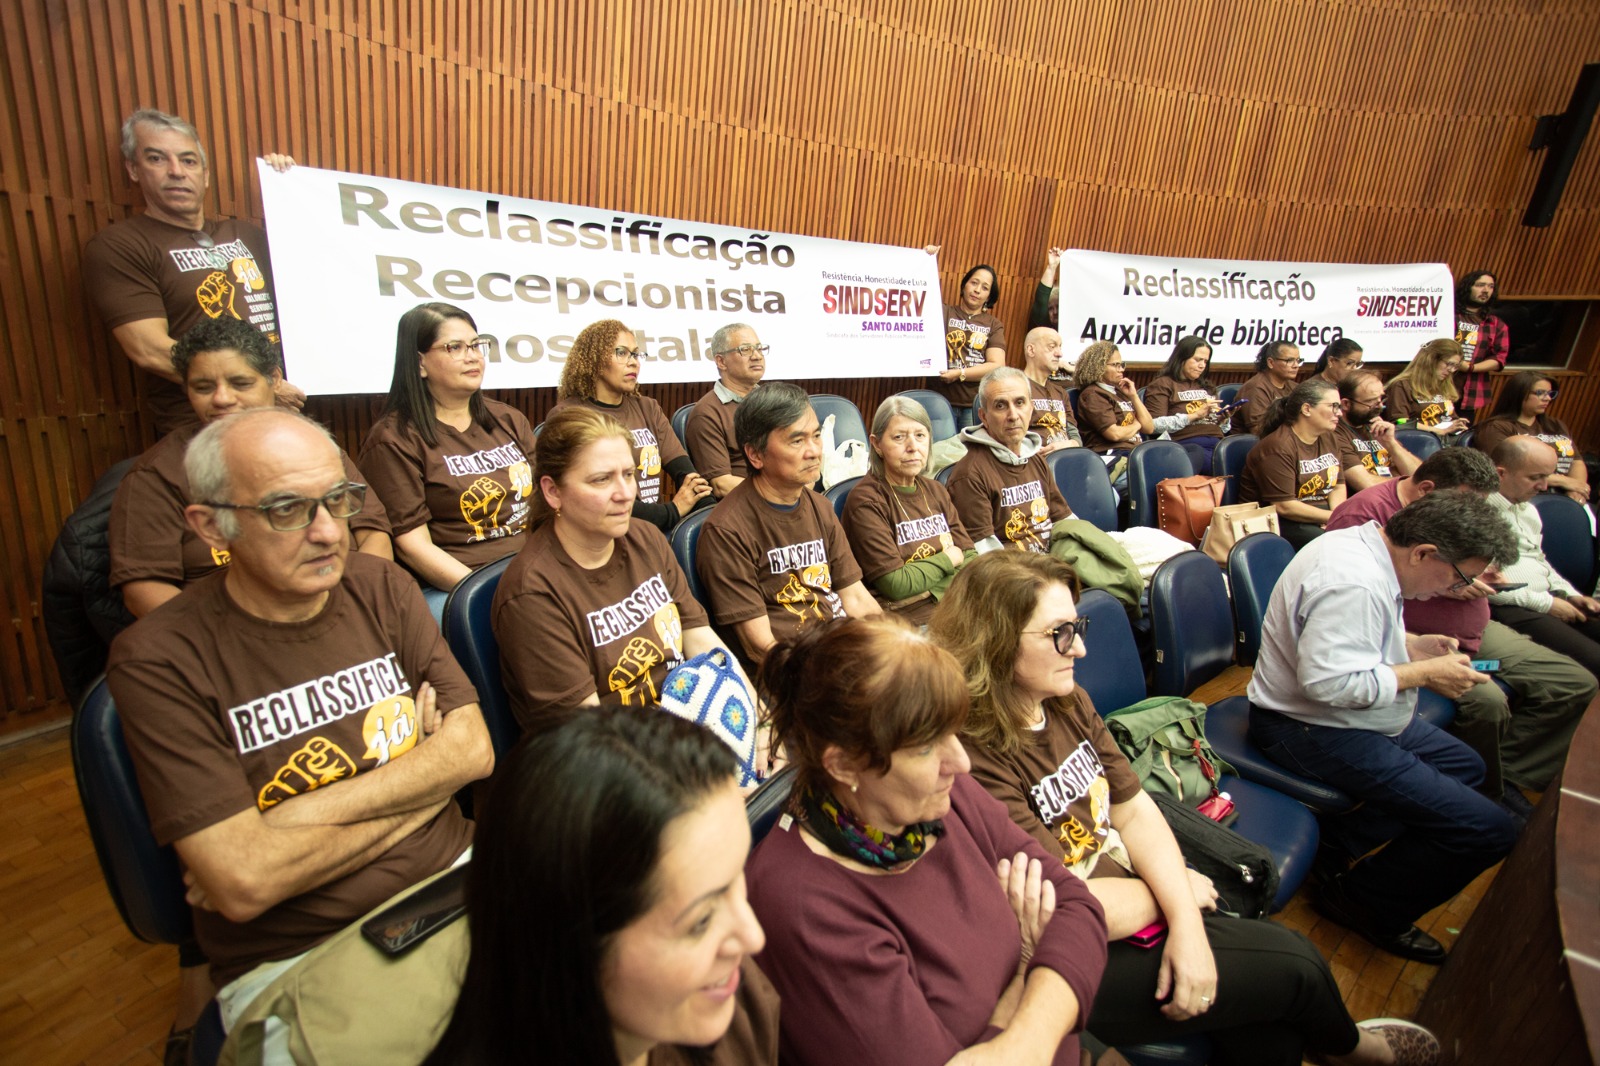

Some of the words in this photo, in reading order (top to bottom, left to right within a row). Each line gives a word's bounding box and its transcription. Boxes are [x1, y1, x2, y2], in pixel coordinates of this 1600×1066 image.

[338, 182, 795, 270] Reclassificação
[375, 254, 786, 314] Recepcionista
[822, 271, 864, 283] Resistência,
[864, 275, 907, 286] Honestidade
[1123, 267, 1316, 307] Reclassificação
[822, 284, 927, 317] SINDSERV
[1357, 295, 1442, 317] SINDSERV
[862, 321, 892, 331] SANTO
[893, 319, 924, 332] ANDRÉ
[1080, 317, 1187, 346] Auxiliar
[1193, 318, 1224, 346] de
[1230, 319, 1343, 346] biblioteca
[1384, 320, 1410, 328] SANTO
[1410, 318, 1438, 328] ANDRÉ
